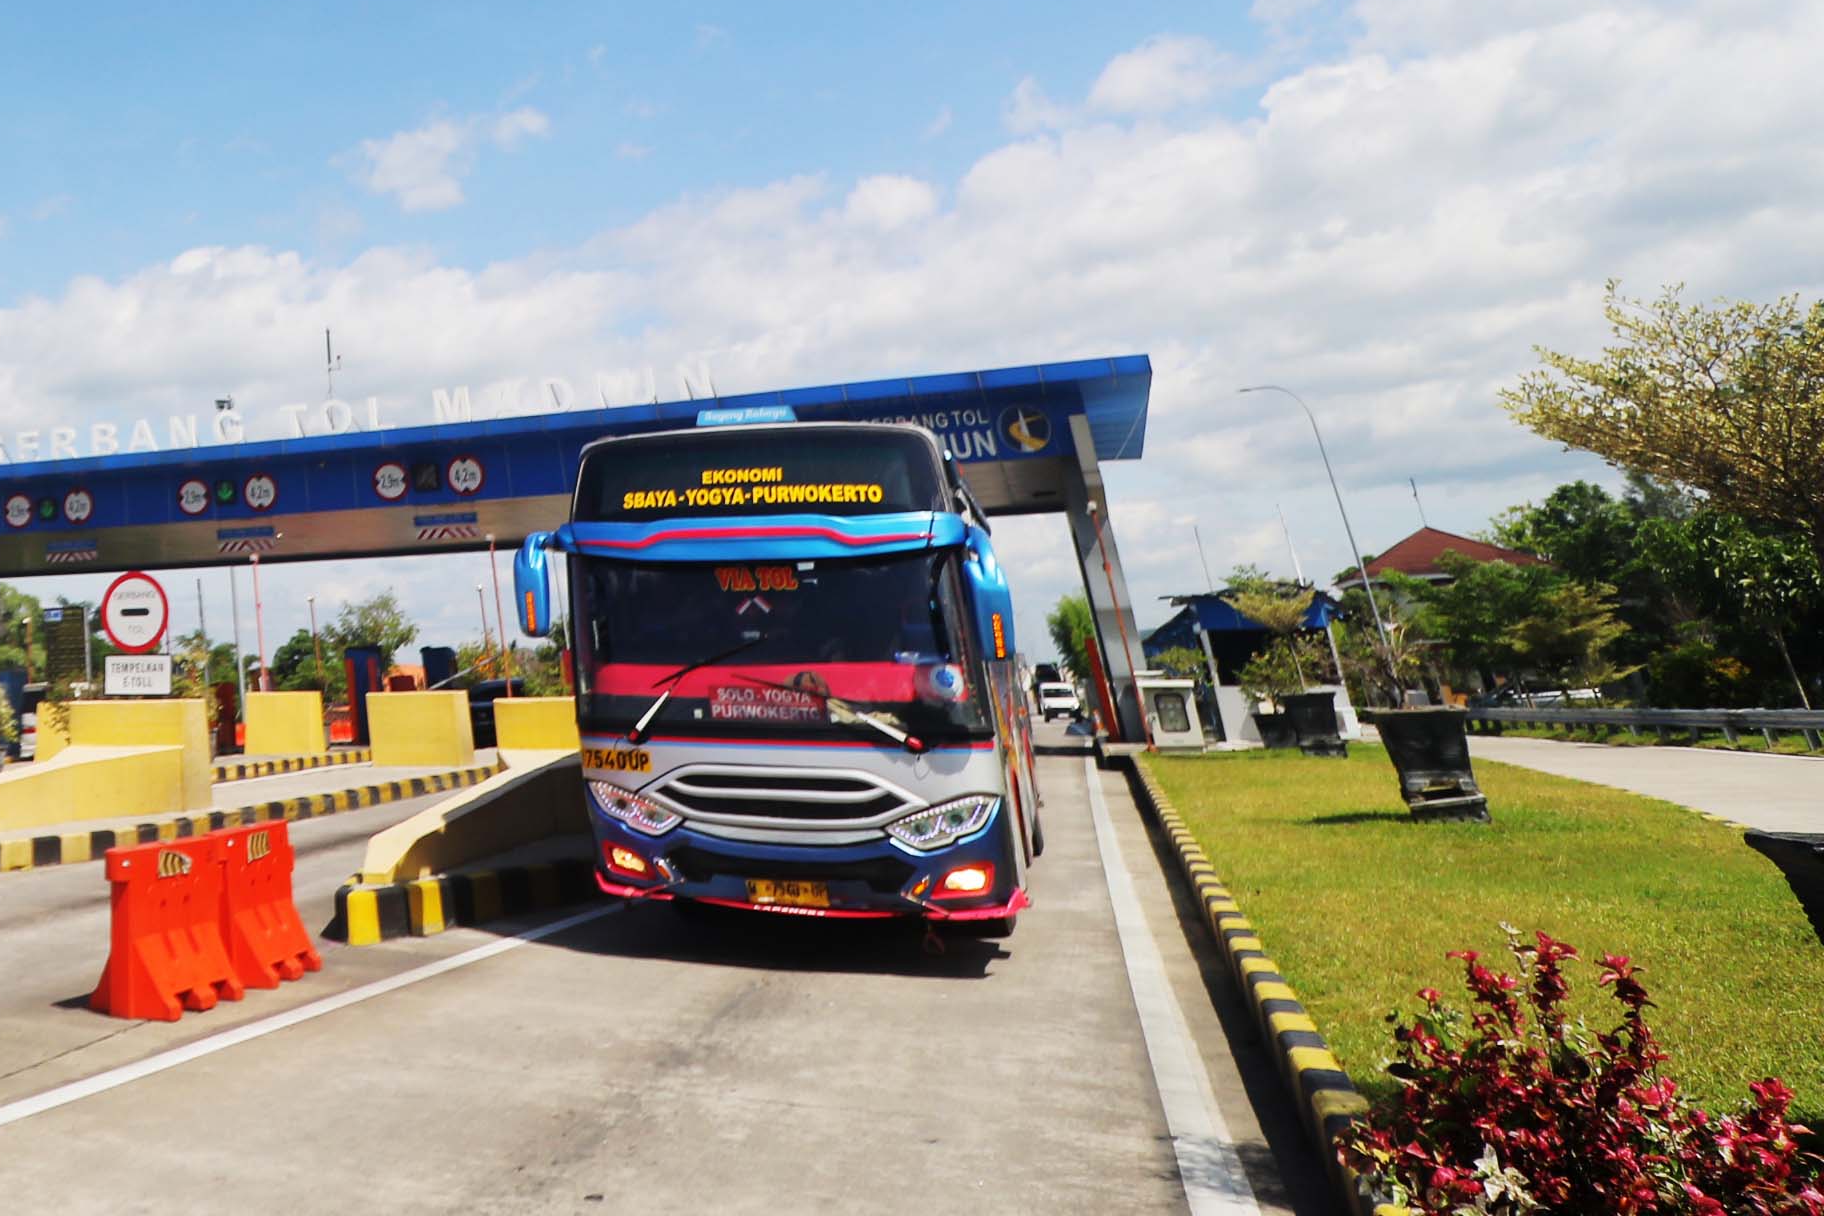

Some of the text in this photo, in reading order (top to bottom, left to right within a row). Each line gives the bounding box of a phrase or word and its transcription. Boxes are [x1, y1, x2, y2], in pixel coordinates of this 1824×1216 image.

[279, 396, 397, 438] TOL
[950, 409, 989, 427] TOL
[701, 467, 783, 484] EKONOMI
[715, 566, 798, 591] VIA TOL
[111, 663, 164, 673] TEMPELKAN
[717, 688, 754, 702] SOLO
[762, 688, 811, 704] YOGYA
